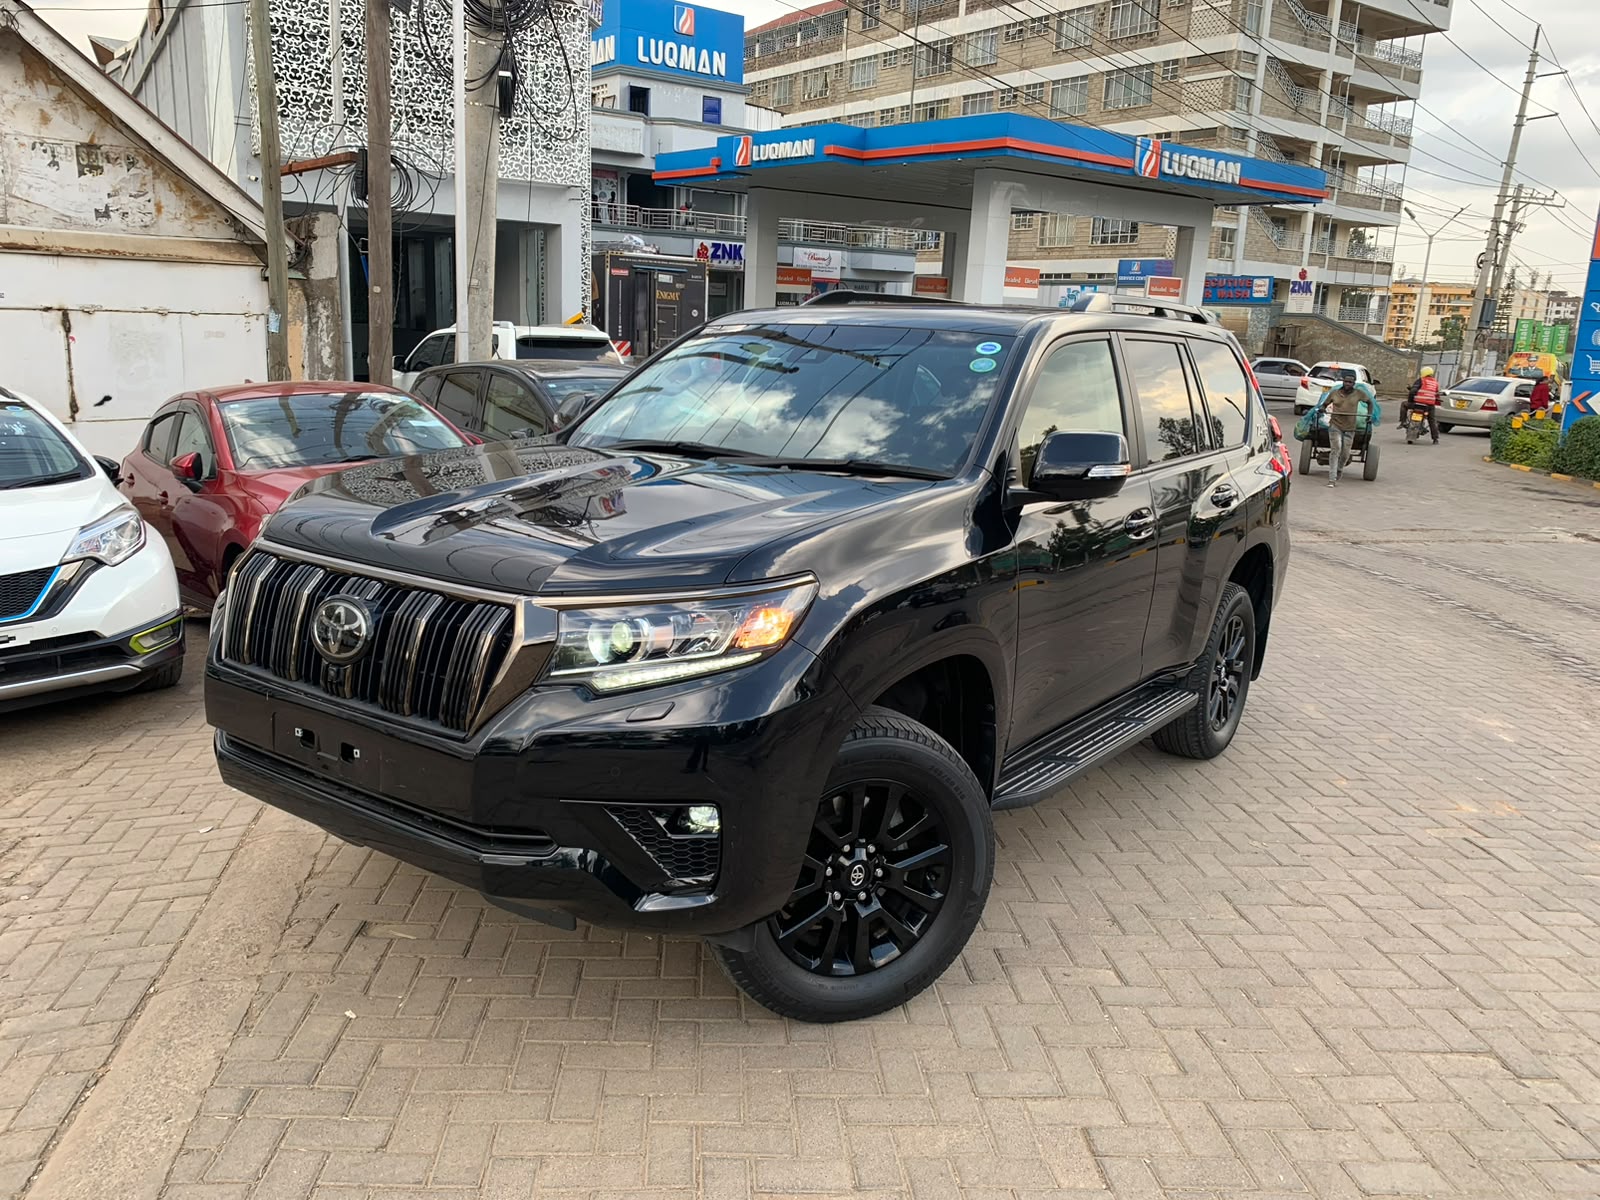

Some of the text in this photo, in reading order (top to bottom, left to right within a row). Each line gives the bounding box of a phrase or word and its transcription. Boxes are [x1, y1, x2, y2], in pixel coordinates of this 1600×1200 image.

[637, 35, 726, 77] LUQMAN
[752, 138, 816, 162] LUQMAN
[1160, 150, 1242, 185] LUQMAN
[710, 242, 743, 261] ZNK
[1290, 280, 1313, 294] ZNK
